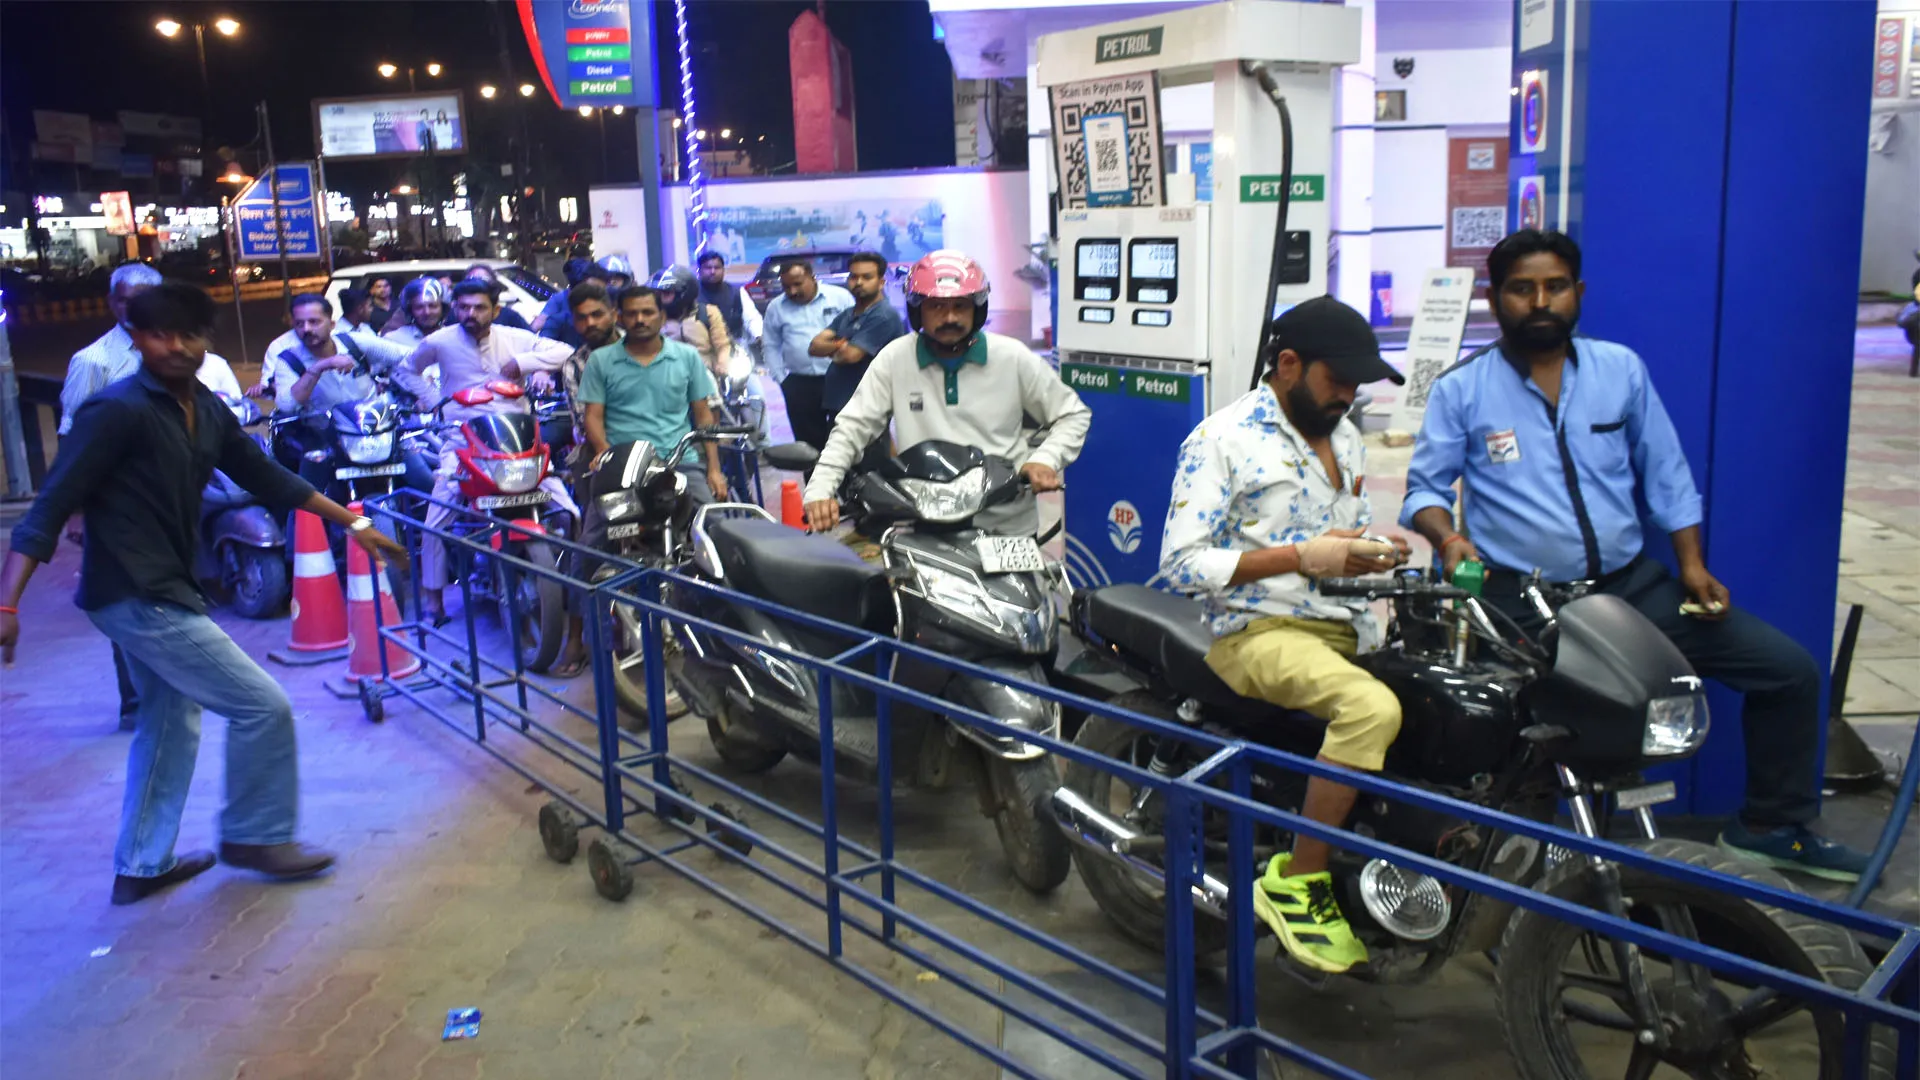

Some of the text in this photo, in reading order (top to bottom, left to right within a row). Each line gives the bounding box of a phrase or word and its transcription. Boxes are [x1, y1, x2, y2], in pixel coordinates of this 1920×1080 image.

[586, 48, 612, 58] Petrol
[1103, 32, 1152, 59] PETROL
[586, 65, 613, 76] Diesel
[581, 81, 617, 93] Petrol
[1093, 82, 1122, 97] Paytm
[1125, 80, 1144, 93] App
[1249, 181, 1315, 196] PETOL
[1071, 368, 1109, 388] Petrol
[1136, 376, 1178, 396] Petrol
[1115, 507, 1134, 525] HP
